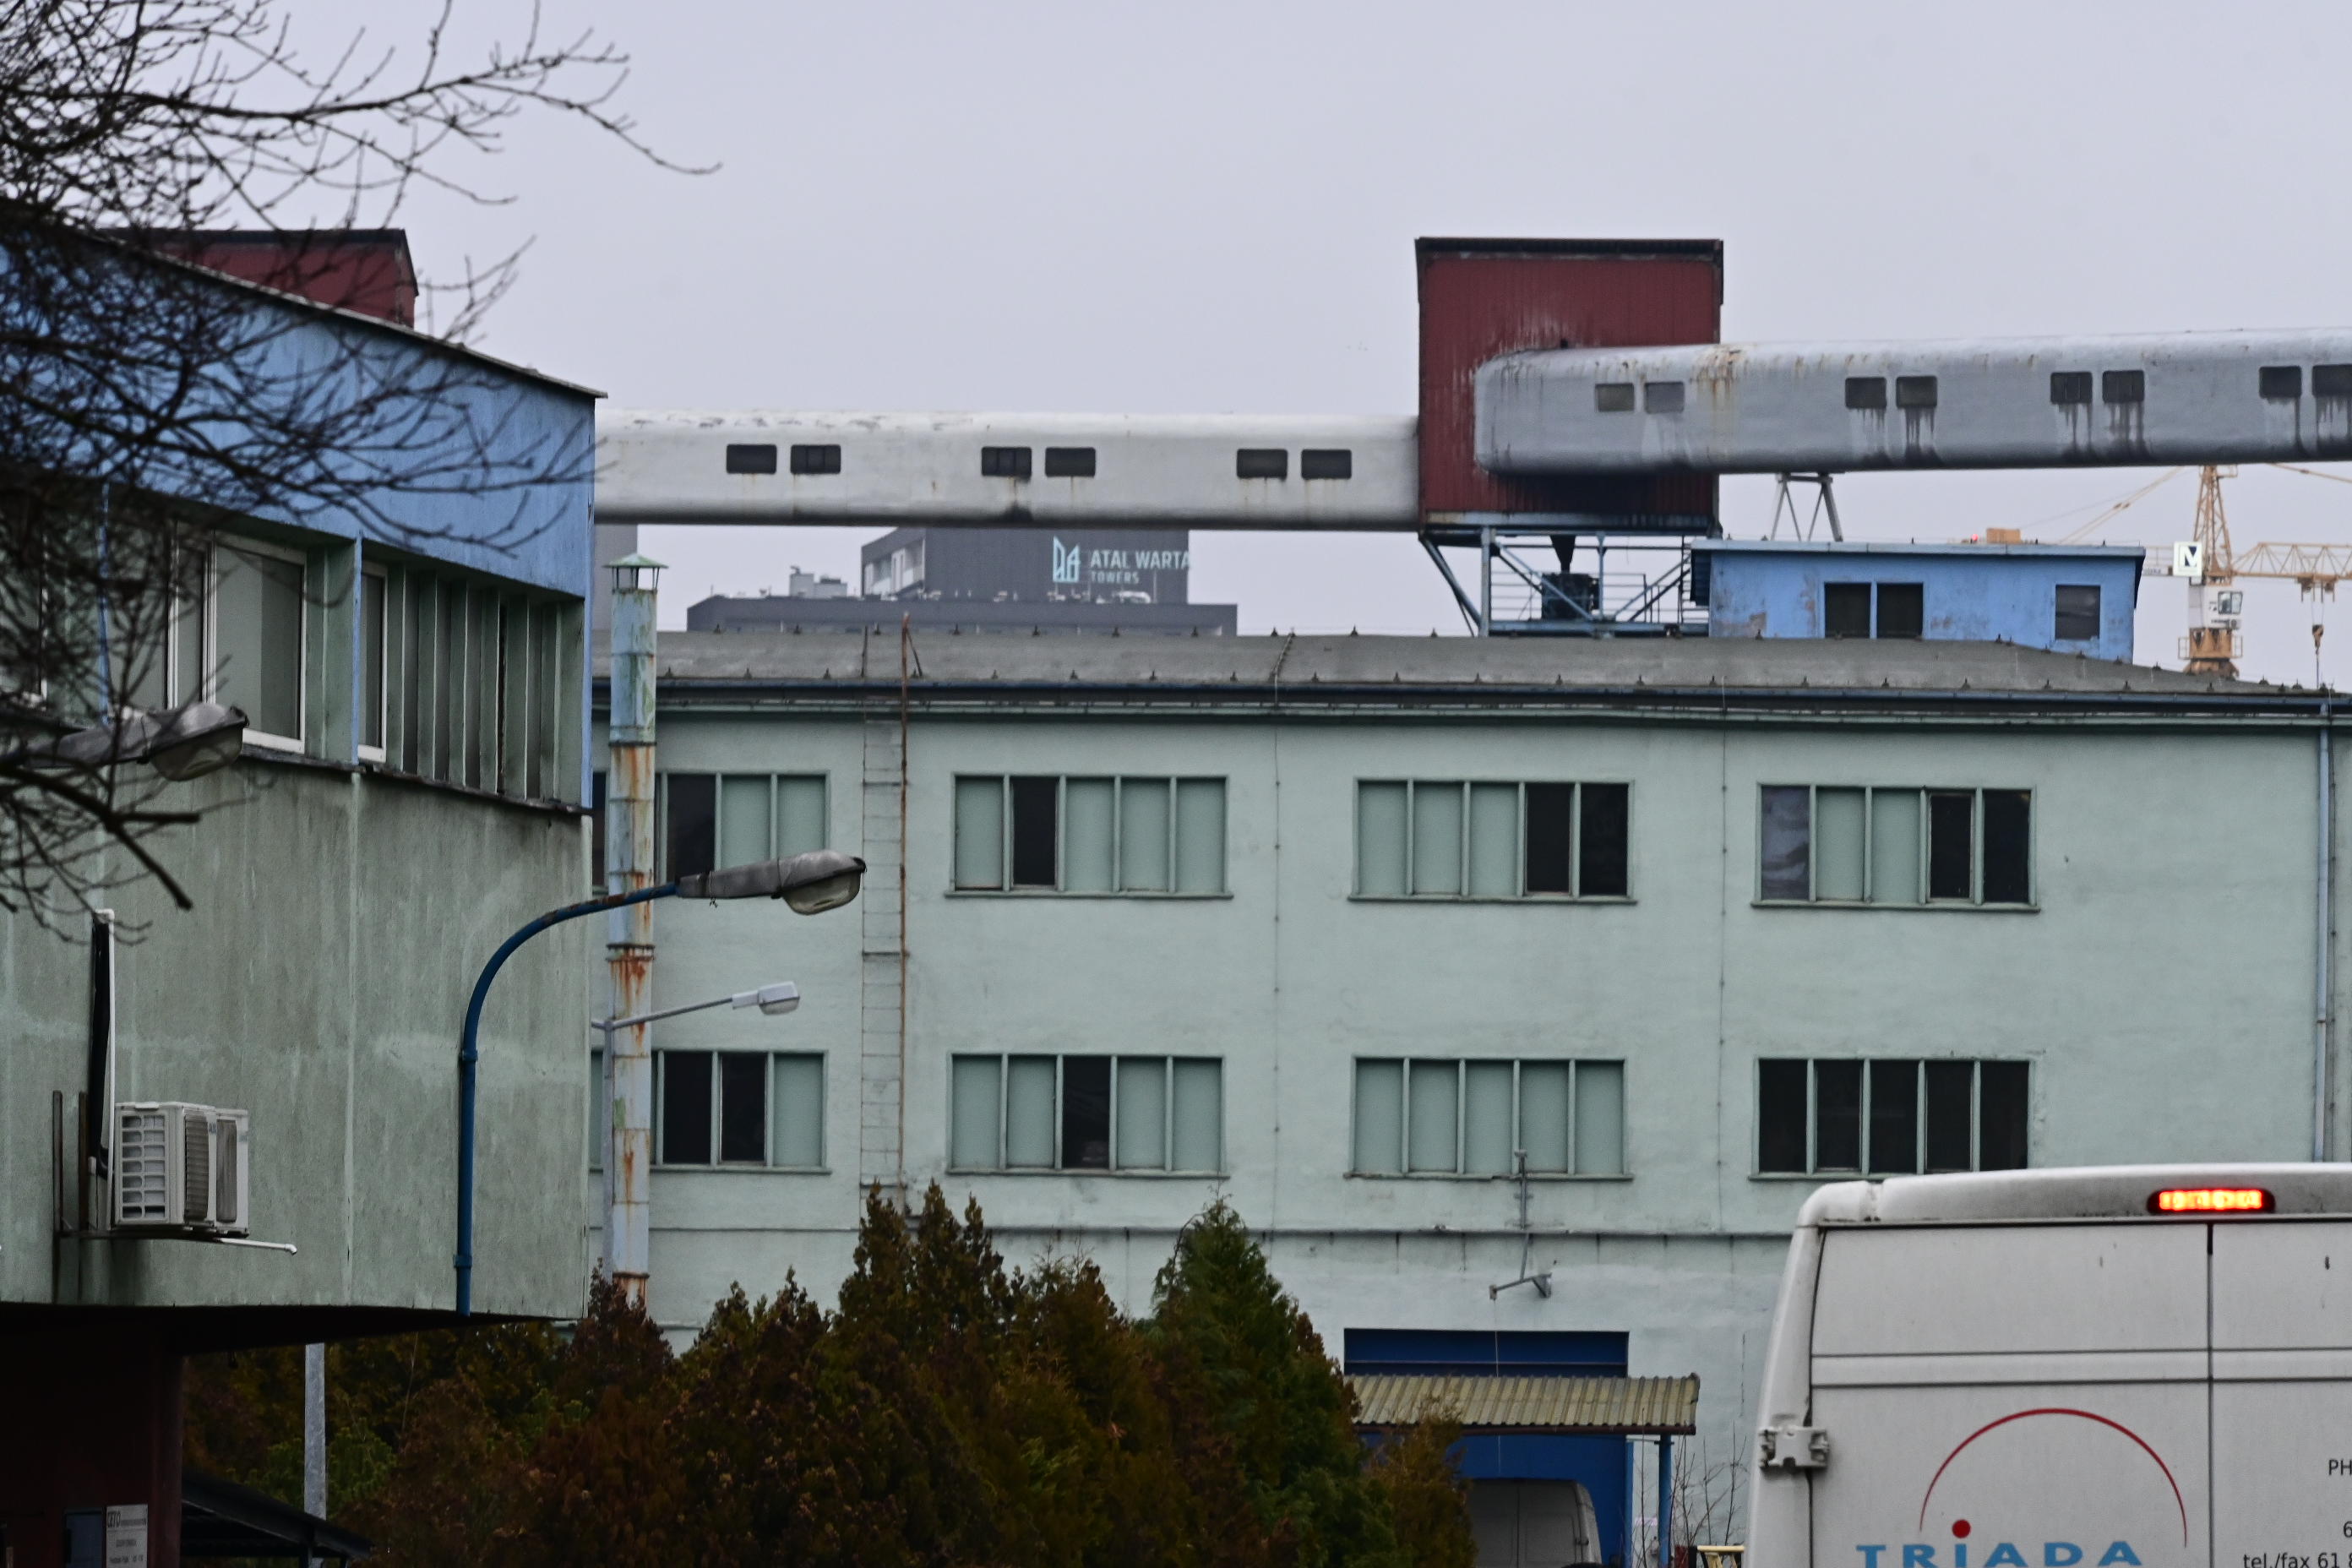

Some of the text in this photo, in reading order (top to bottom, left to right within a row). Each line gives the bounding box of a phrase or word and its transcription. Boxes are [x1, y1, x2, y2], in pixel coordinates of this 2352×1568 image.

[1090, 550, 1190, 569] ATAL WARTA
[1091, 570, 1139, 584] TOWERS
[2317, 1552, 2339, 1568] 61
